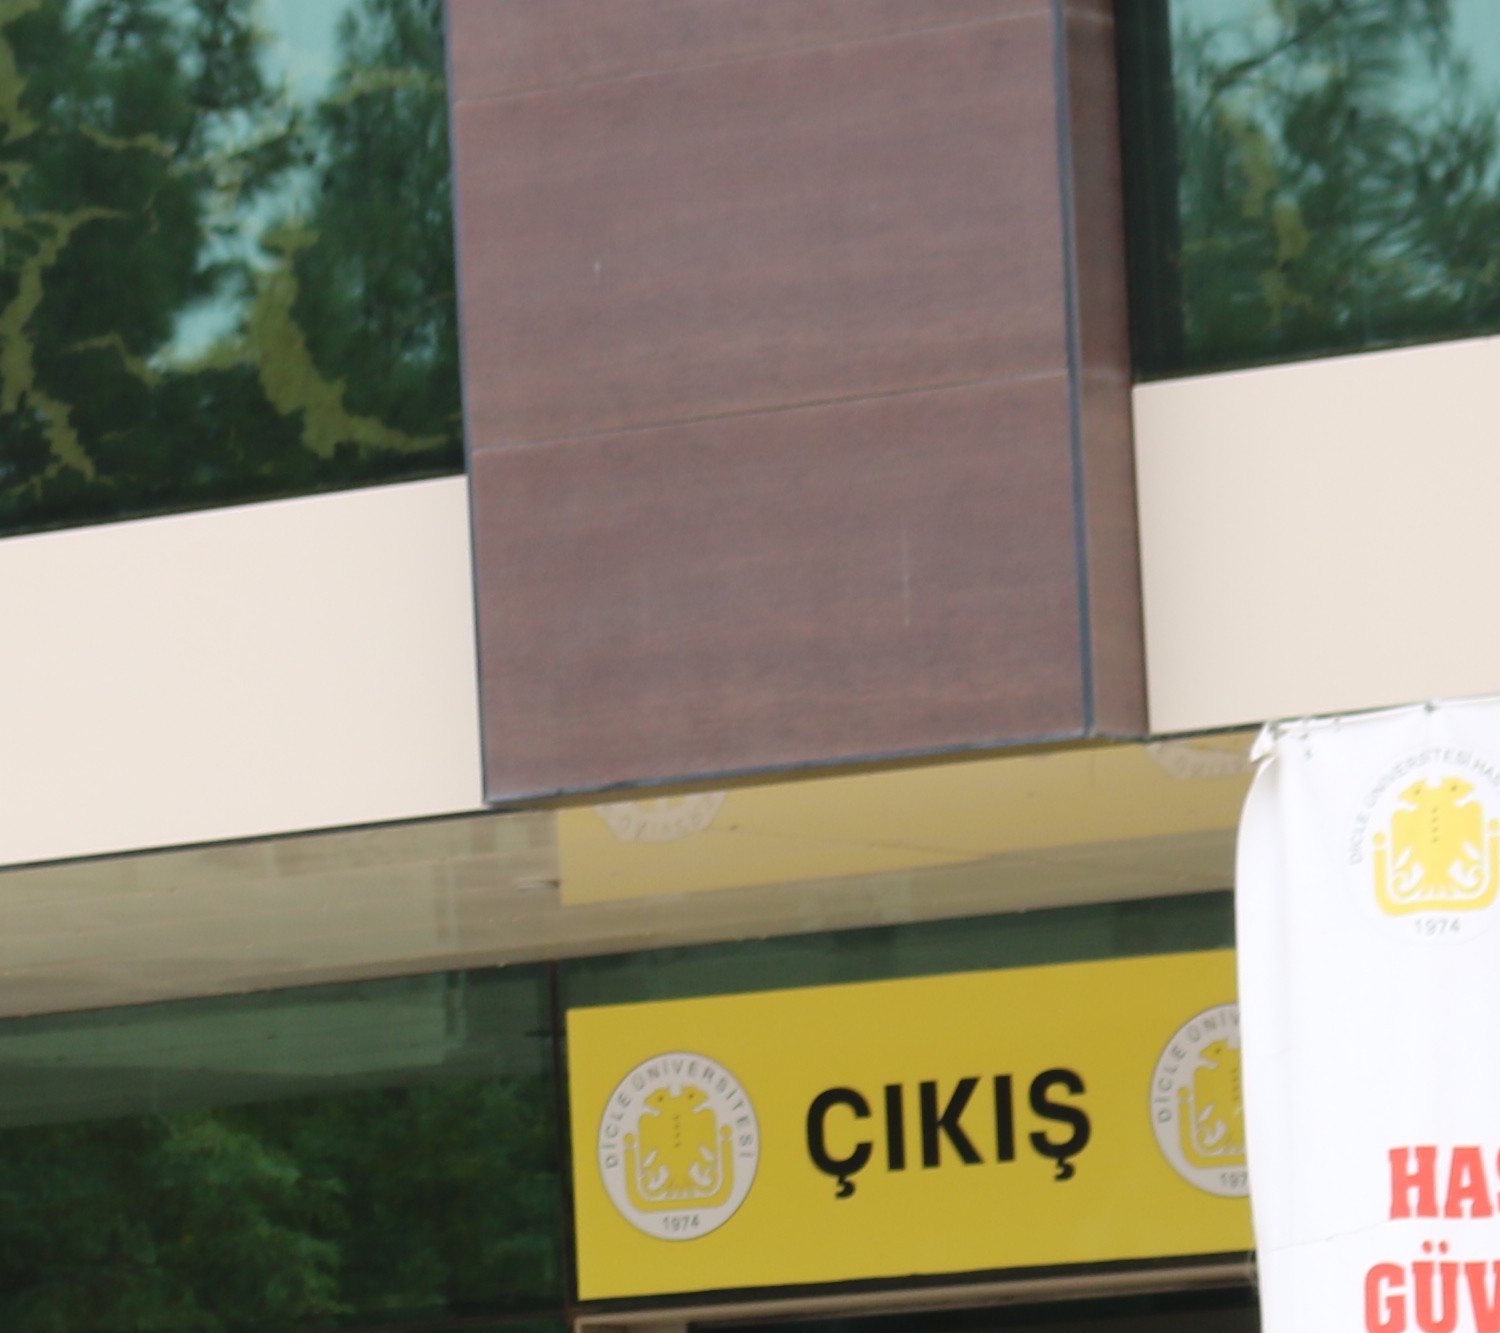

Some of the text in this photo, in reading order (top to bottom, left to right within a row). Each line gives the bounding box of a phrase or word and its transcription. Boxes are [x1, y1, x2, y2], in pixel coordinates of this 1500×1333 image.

[1415, 918, 1461, 935] 1974
[804, 1067, 1092, 1199] ÇIKIŞ
[1220, 1171, 1248, 1189] 197
[663, 1213, 700, 1232] 1974
